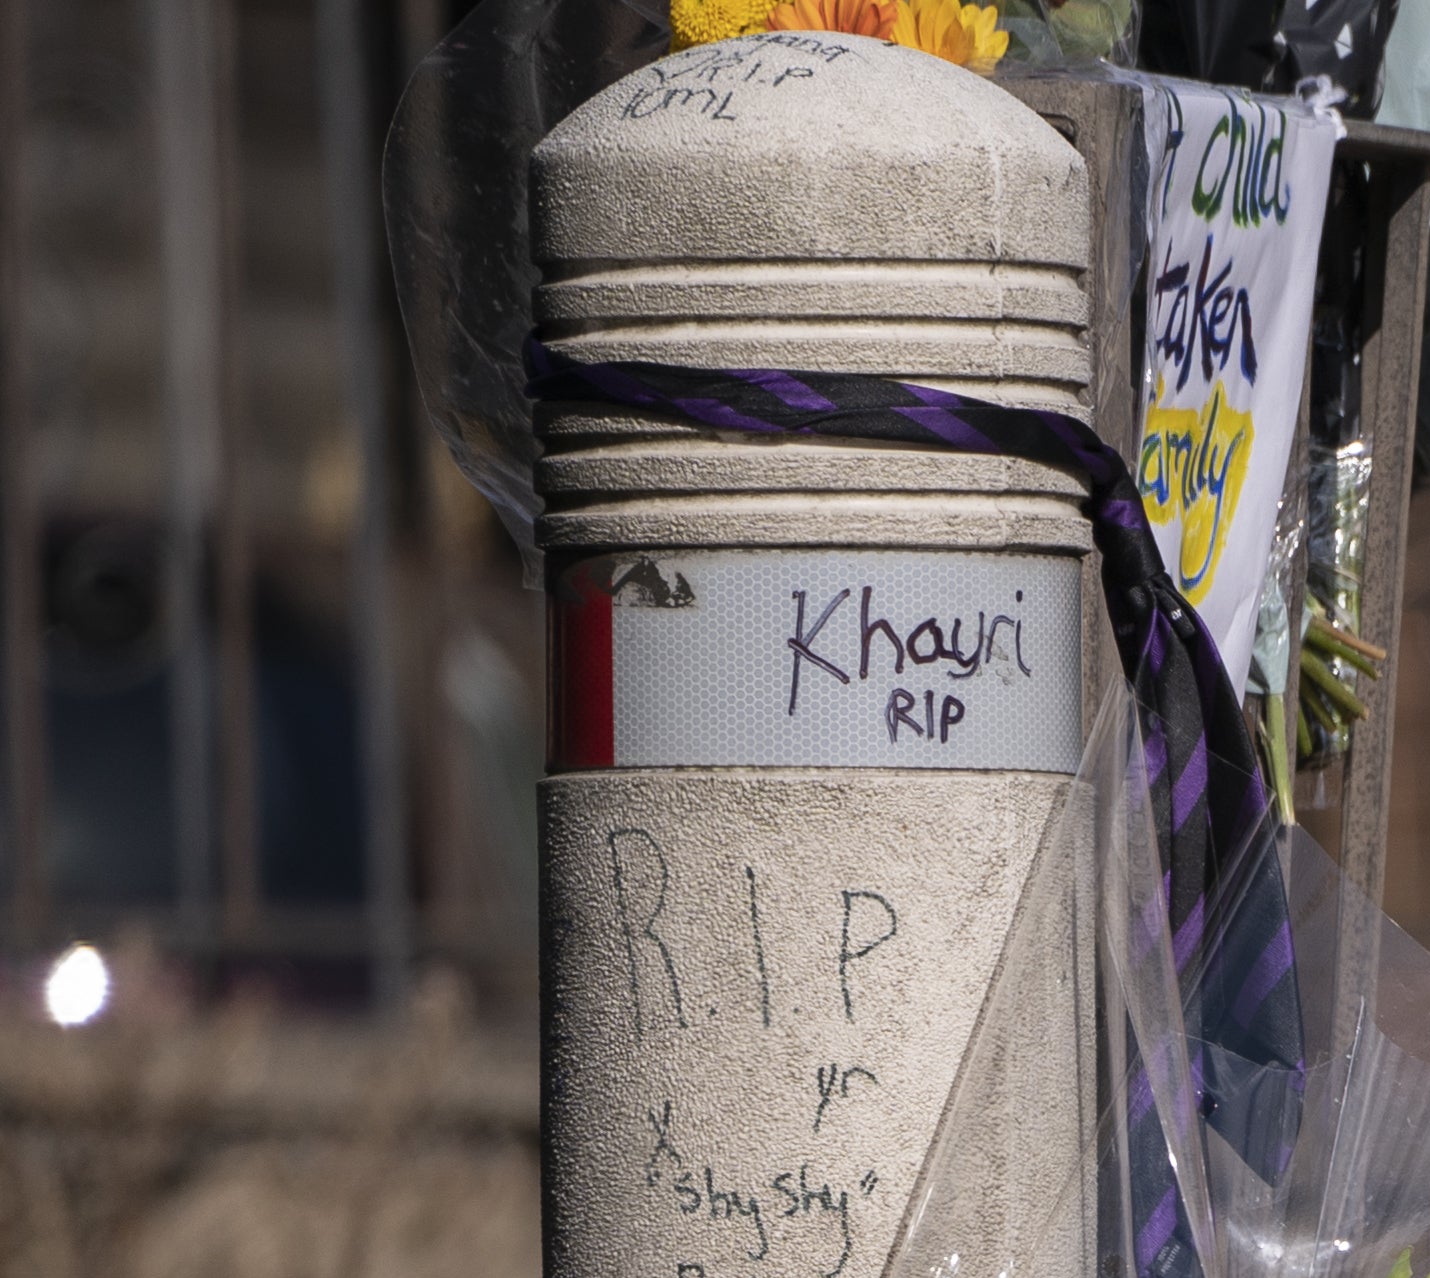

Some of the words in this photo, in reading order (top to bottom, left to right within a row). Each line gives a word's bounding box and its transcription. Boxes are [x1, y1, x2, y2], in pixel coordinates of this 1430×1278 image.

[1192, 94, 1290, 228] child
[1155, 232, 1257, 394] taken
[1138, 388, 1246, 593] amily
[787, 584, 1032, 717] Khayri
[884, 687, 966, 745] RIP
